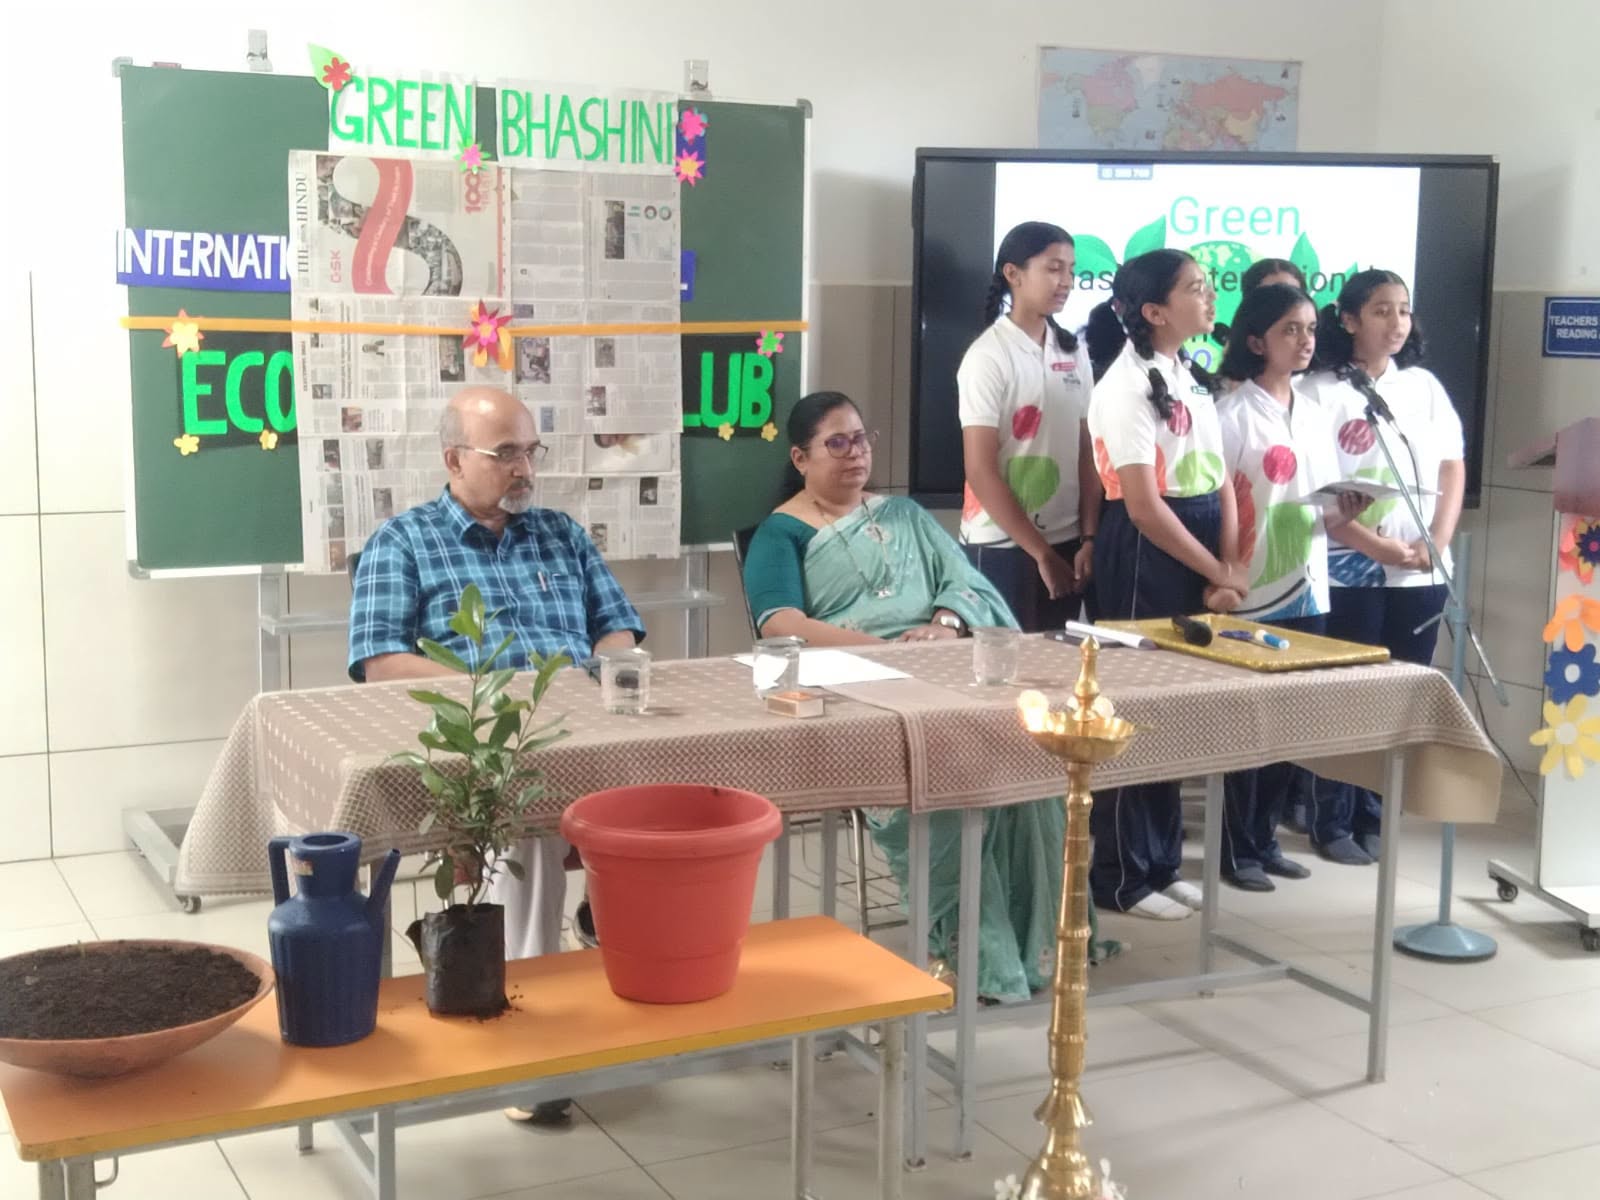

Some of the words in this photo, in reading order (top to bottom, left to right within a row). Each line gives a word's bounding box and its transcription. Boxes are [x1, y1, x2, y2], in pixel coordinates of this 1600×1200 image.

[331, 76, 473, 150] GREEN
[501, 88, 673, 165] BHASHINI
[1169, 195, 1300, 236] Green
[116, 228, 290, 280] INTERNATI
[1550, 315, 1598, 326] TEACHERS
[1556, 328, 1597, 339] READING
[182, 349, 297, 435] ECO
